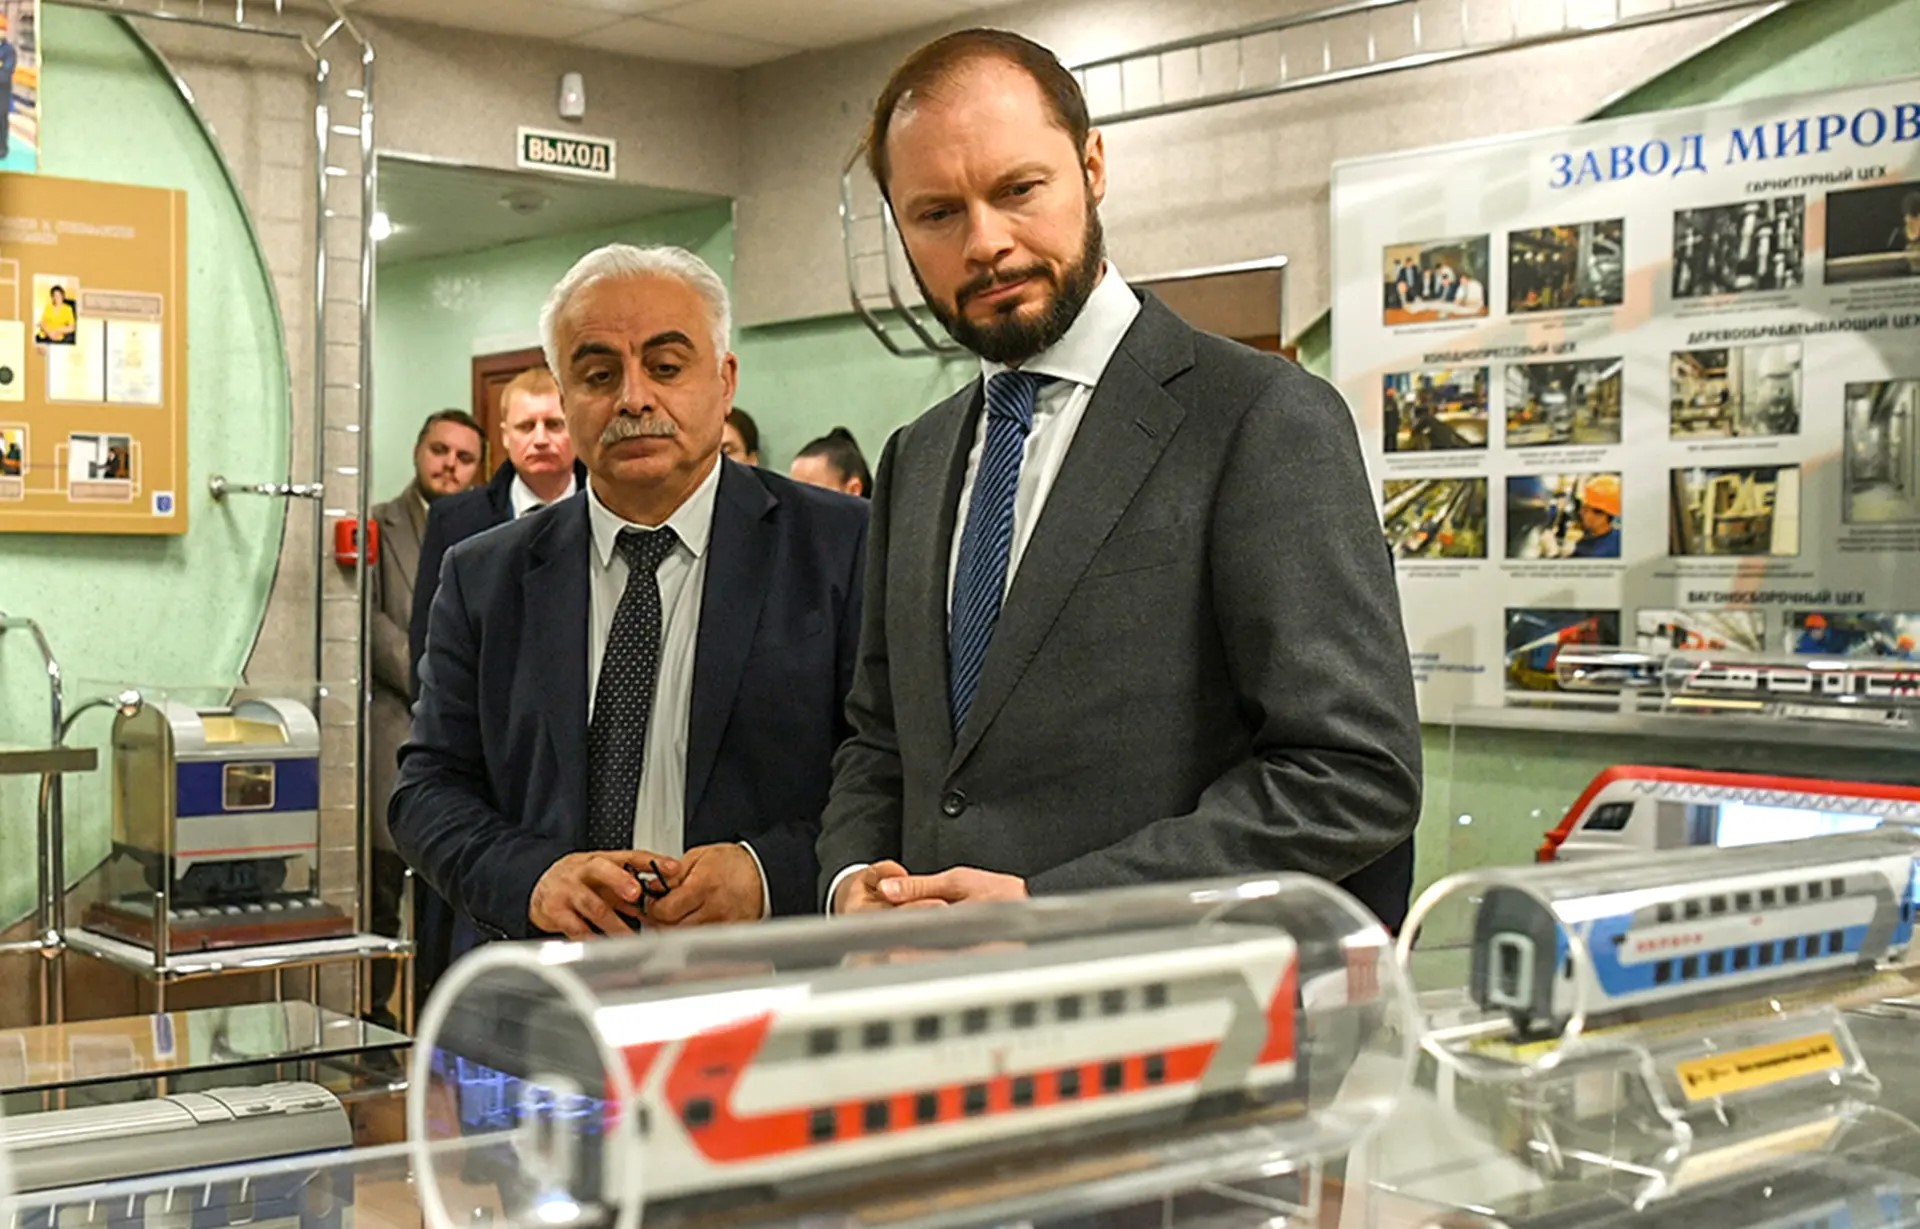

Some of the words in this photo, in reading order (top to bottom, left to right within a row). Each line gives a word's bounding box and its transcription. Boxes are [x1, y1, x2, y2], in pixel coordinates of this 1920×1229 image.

[528, 137, 607, 170] ВЫХОД
[1549, 133, 1708, 190] ЗАВОД
[1725, 102, 1920, 166] МИРОВ
[1746, 167, 1853, 194] ГАРНИТУРНЫЙ
[1857, 165, 1888, 182] ЦЕХ
[1686, 311, 1889, 345] ДЕРЕВООБРАБАТЫВАЮЩИЙ
[1688, 588, 1831, 604] ВАГОНОСБОРОЧНЫЙ
[1835, 590, 1866, 605] ЦЕХ
